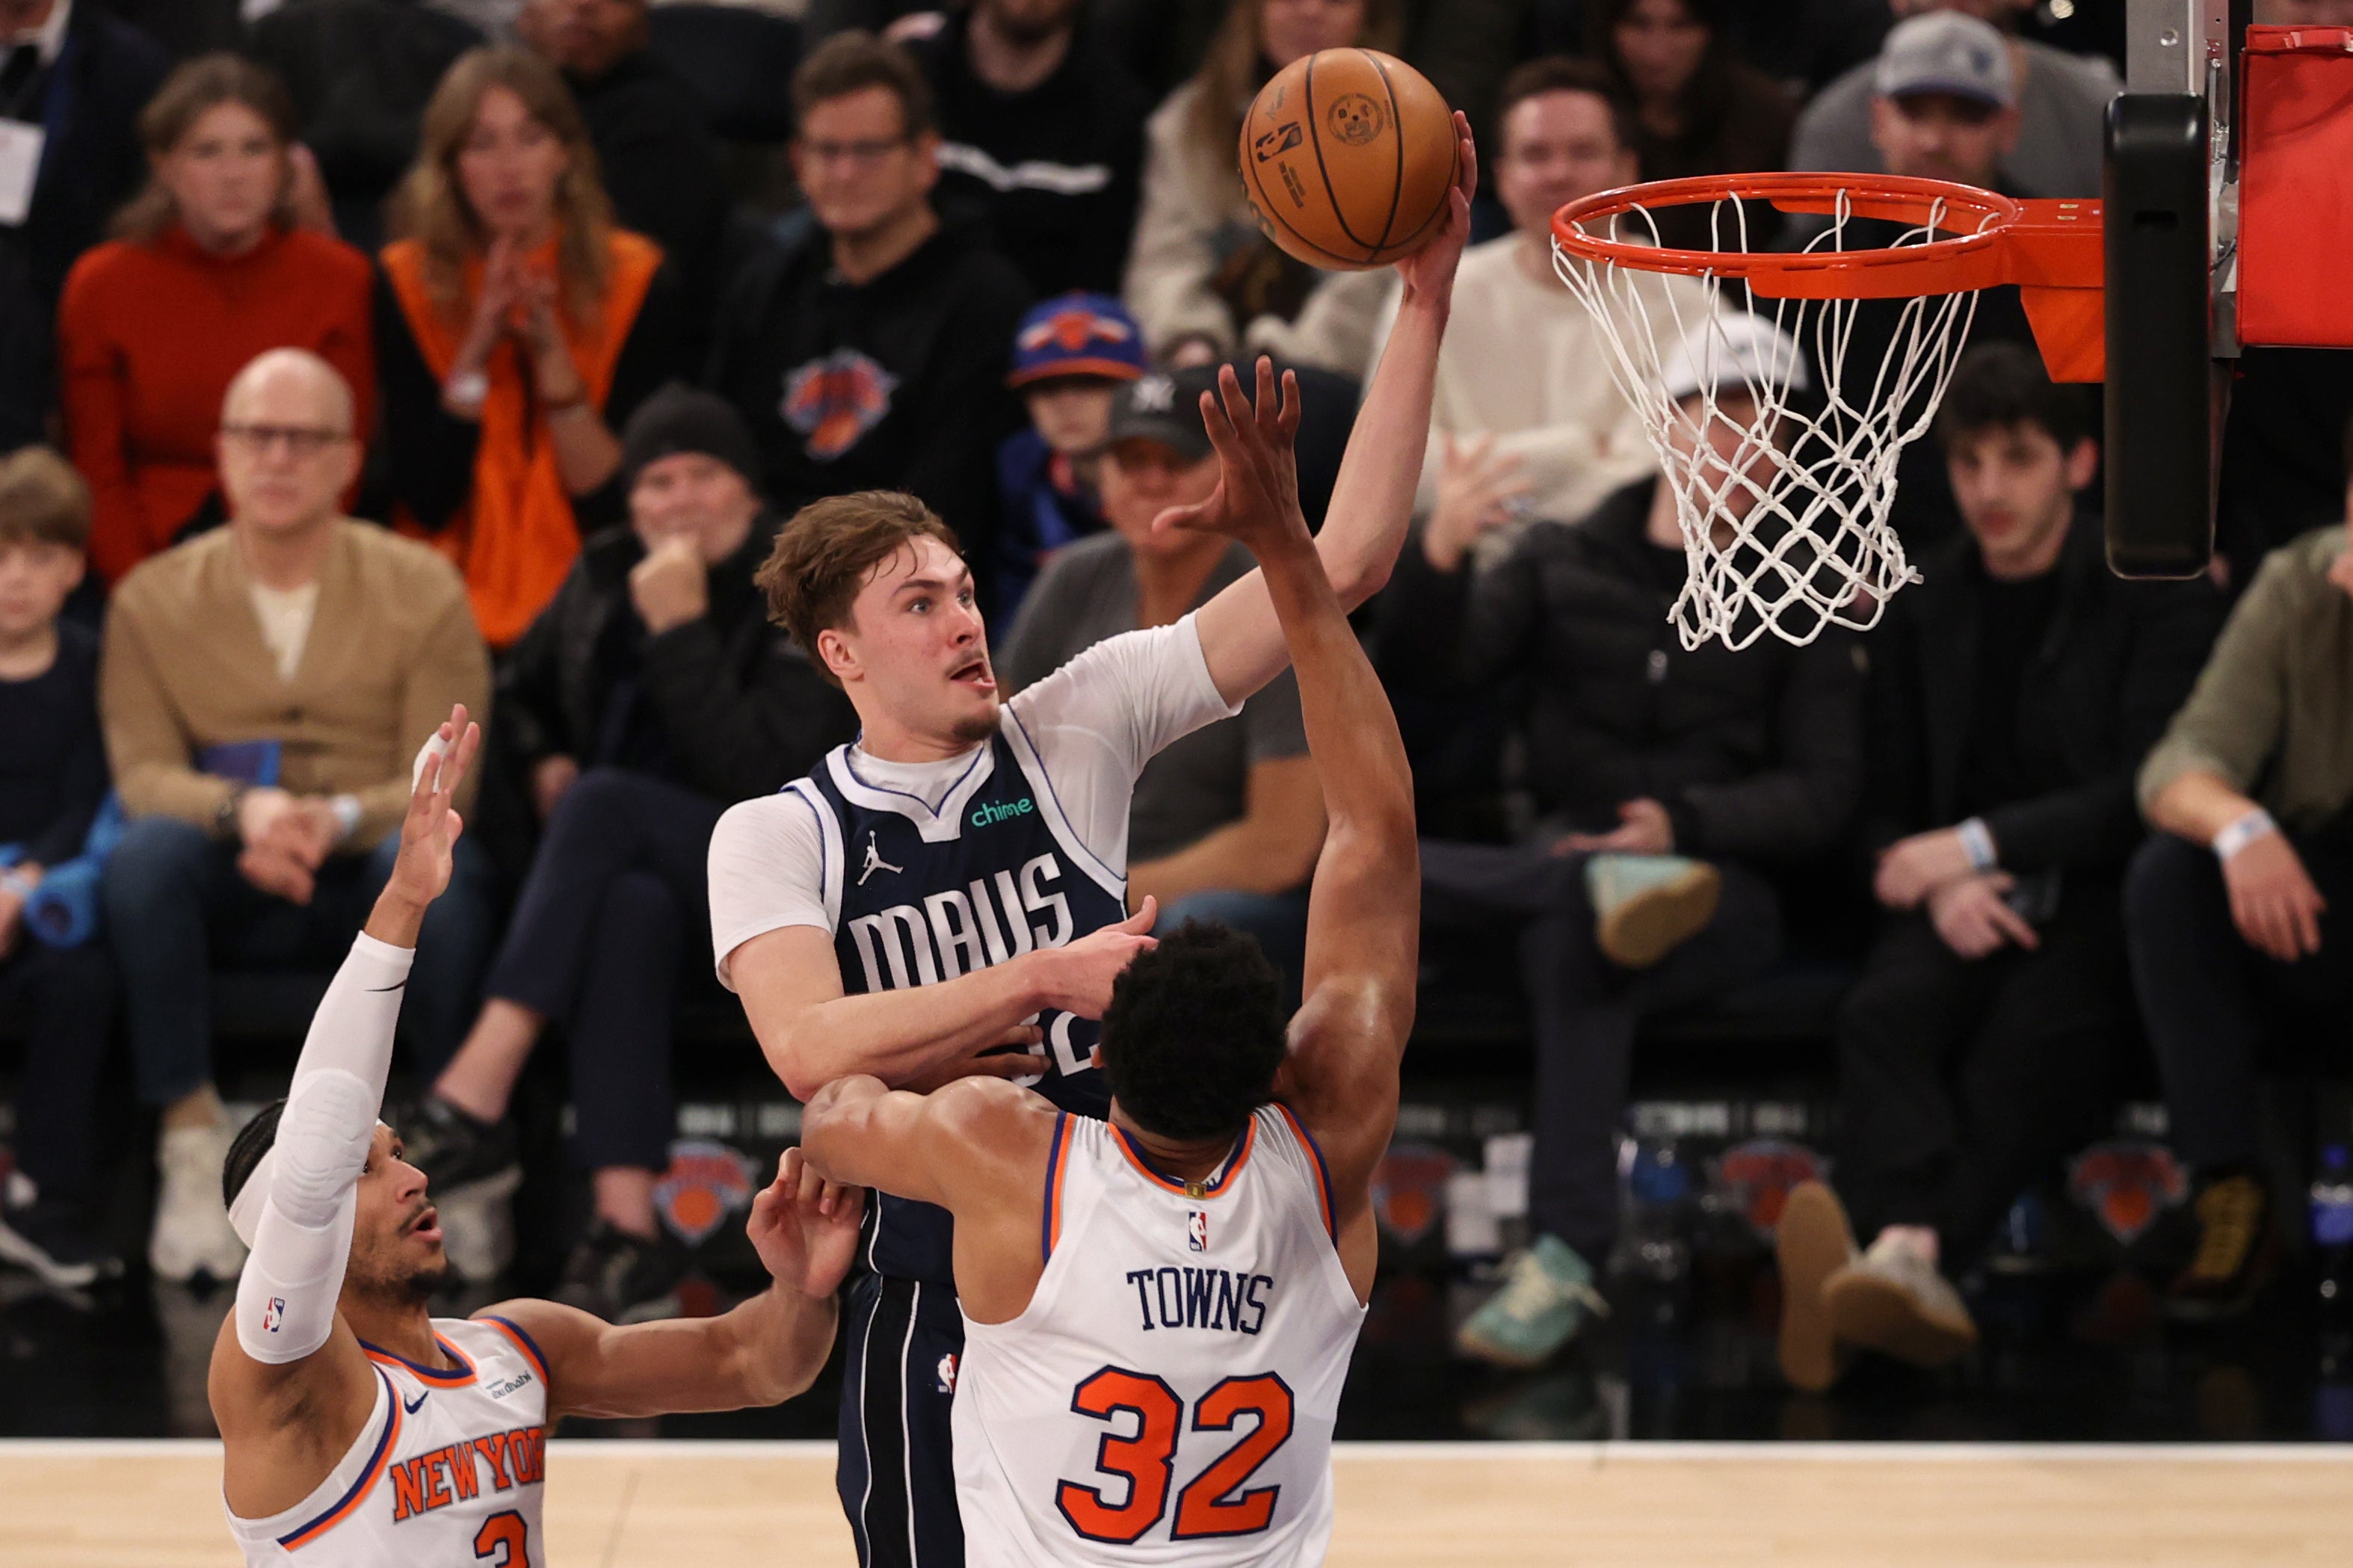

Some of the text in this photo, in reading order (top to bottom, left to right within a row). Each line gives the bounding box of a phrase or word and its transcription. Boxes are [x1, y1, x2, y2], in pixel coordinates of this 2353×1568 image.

[971, 797, 1034, 827] chime
[848, 852, 1074, 993] MAVS
[1126, 1266, 1274, 1336] TOWNS
[389, 1440, 480, 1525] NEW
[1055, 1364, 1295, 1546] 32
